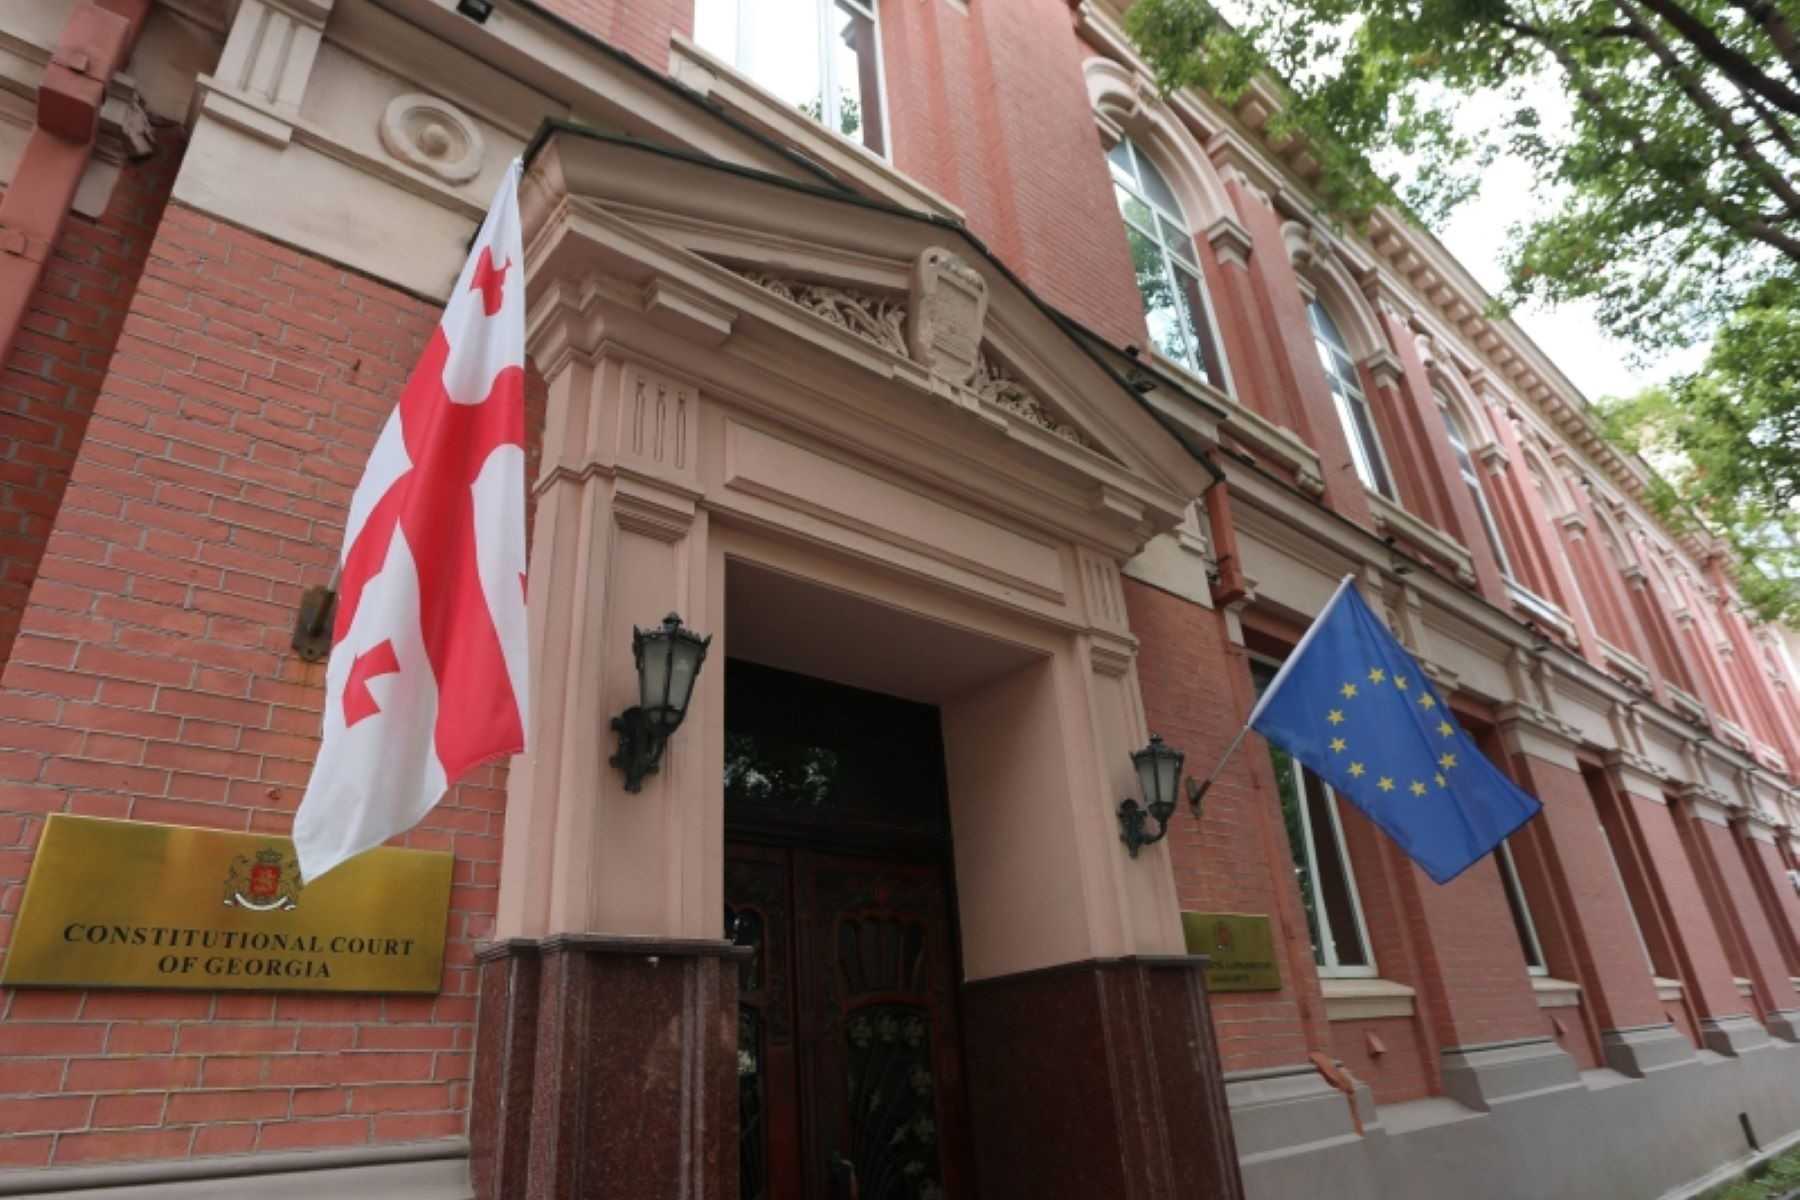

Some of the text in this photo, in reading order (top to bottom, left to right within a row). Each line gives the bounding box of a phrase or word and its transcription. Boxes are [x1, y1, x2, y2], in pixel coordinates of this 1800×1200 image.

[63, 923, 415, 956] CONSTITUTIONAL COURT
[157, 955, 331, 978] OF GEORGIA
